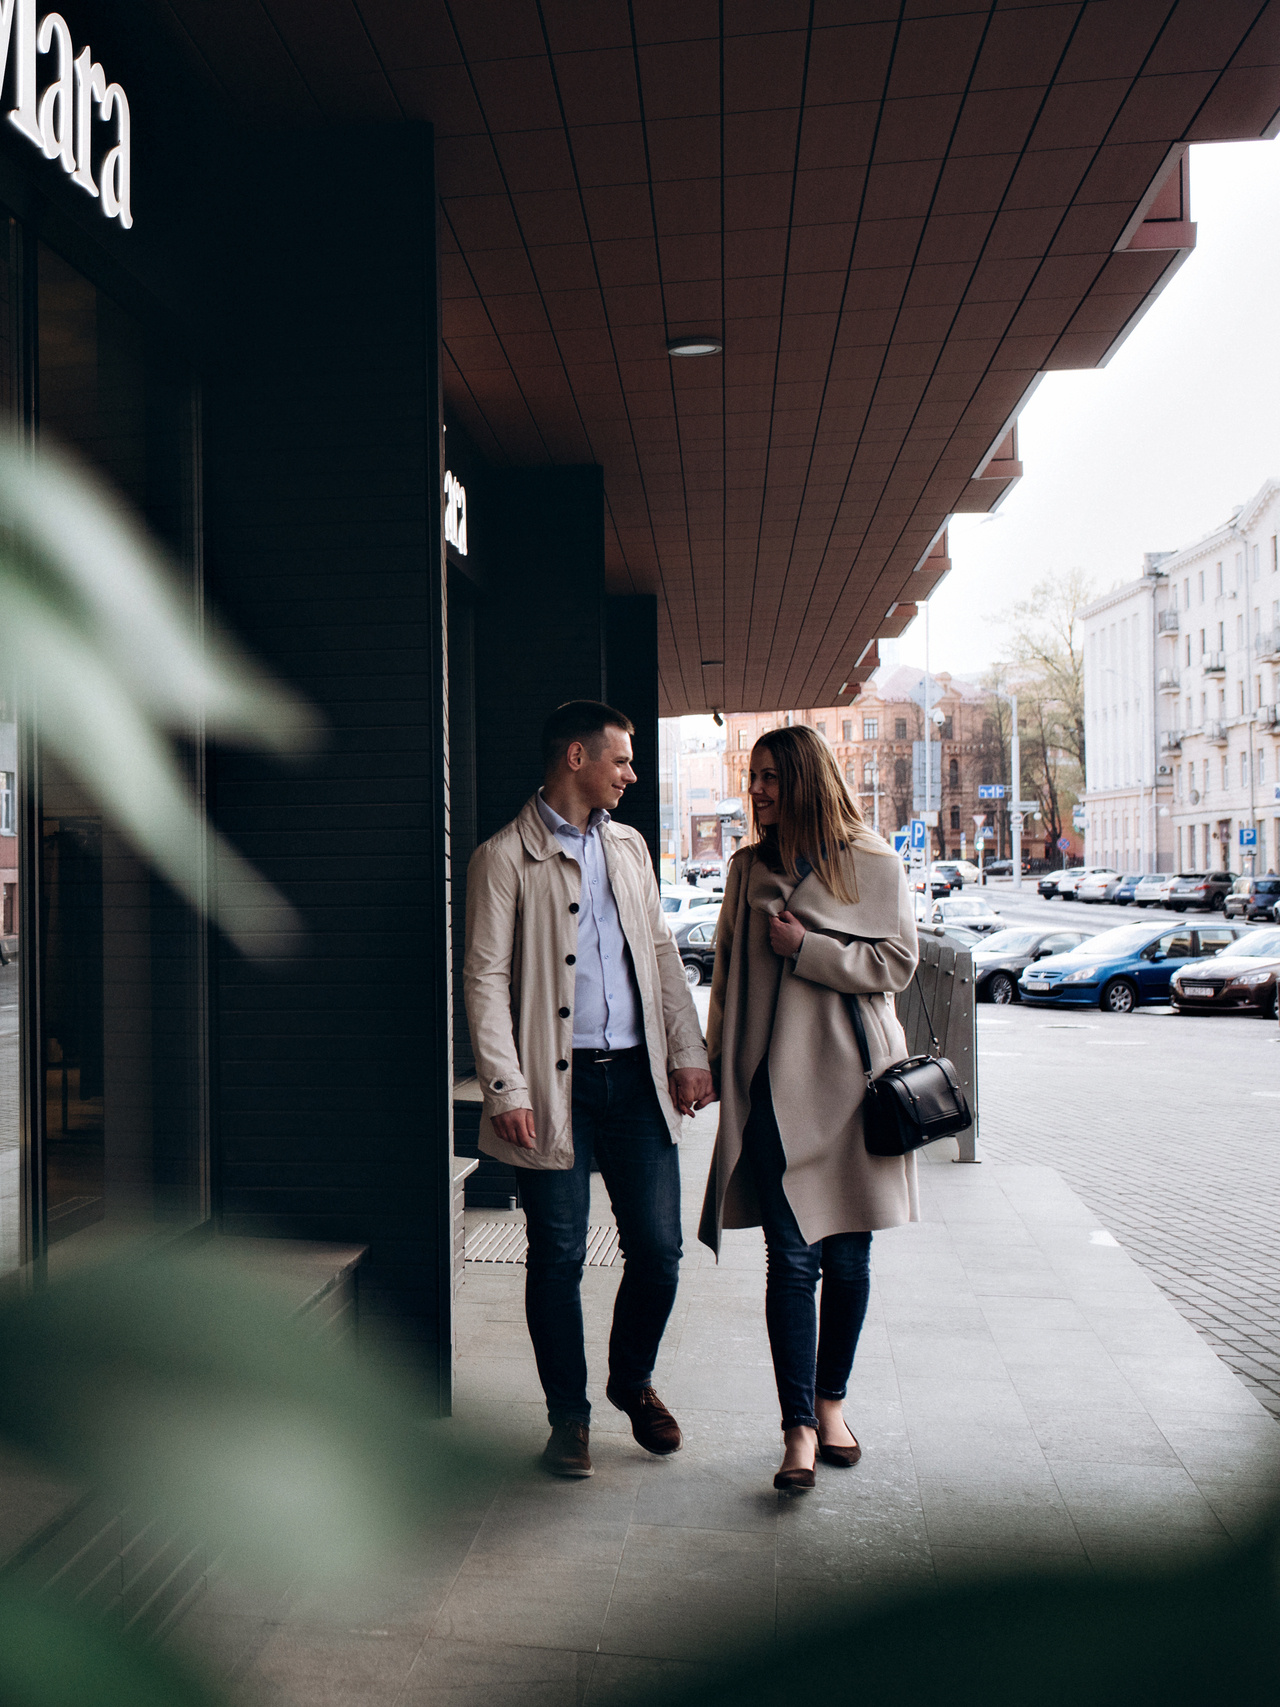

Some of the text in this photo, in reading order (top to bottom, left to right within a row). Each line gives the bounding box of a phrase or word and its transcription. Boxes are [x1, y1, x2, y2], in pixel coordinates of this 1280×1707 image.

[443, 470, 468, 556] ara
[914, 822, 924, 846] P
[1242, 830, 1254, 845] P
